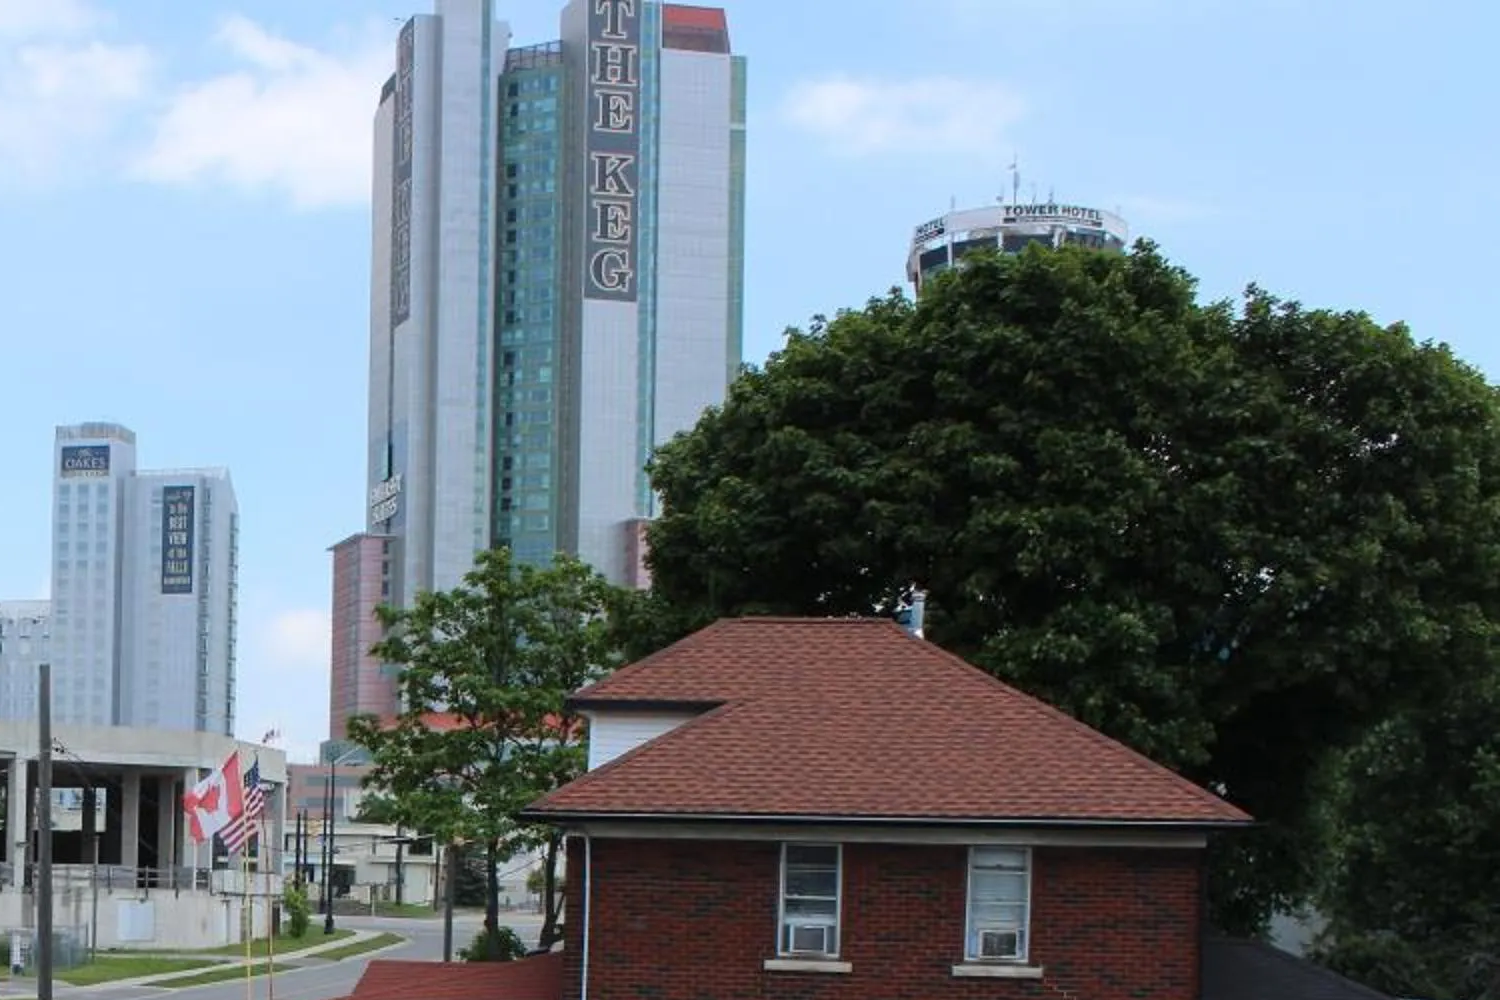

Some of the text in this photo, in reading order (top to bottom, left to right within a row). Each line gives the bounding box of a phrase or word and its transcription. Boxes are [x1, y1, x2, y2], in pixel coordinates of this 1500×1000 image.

[590, 0, 637, 293] THE KEG
[1004, 204, 1103, 220] TOWER HOTEL
[65, 456, 105, 469] OAKES
